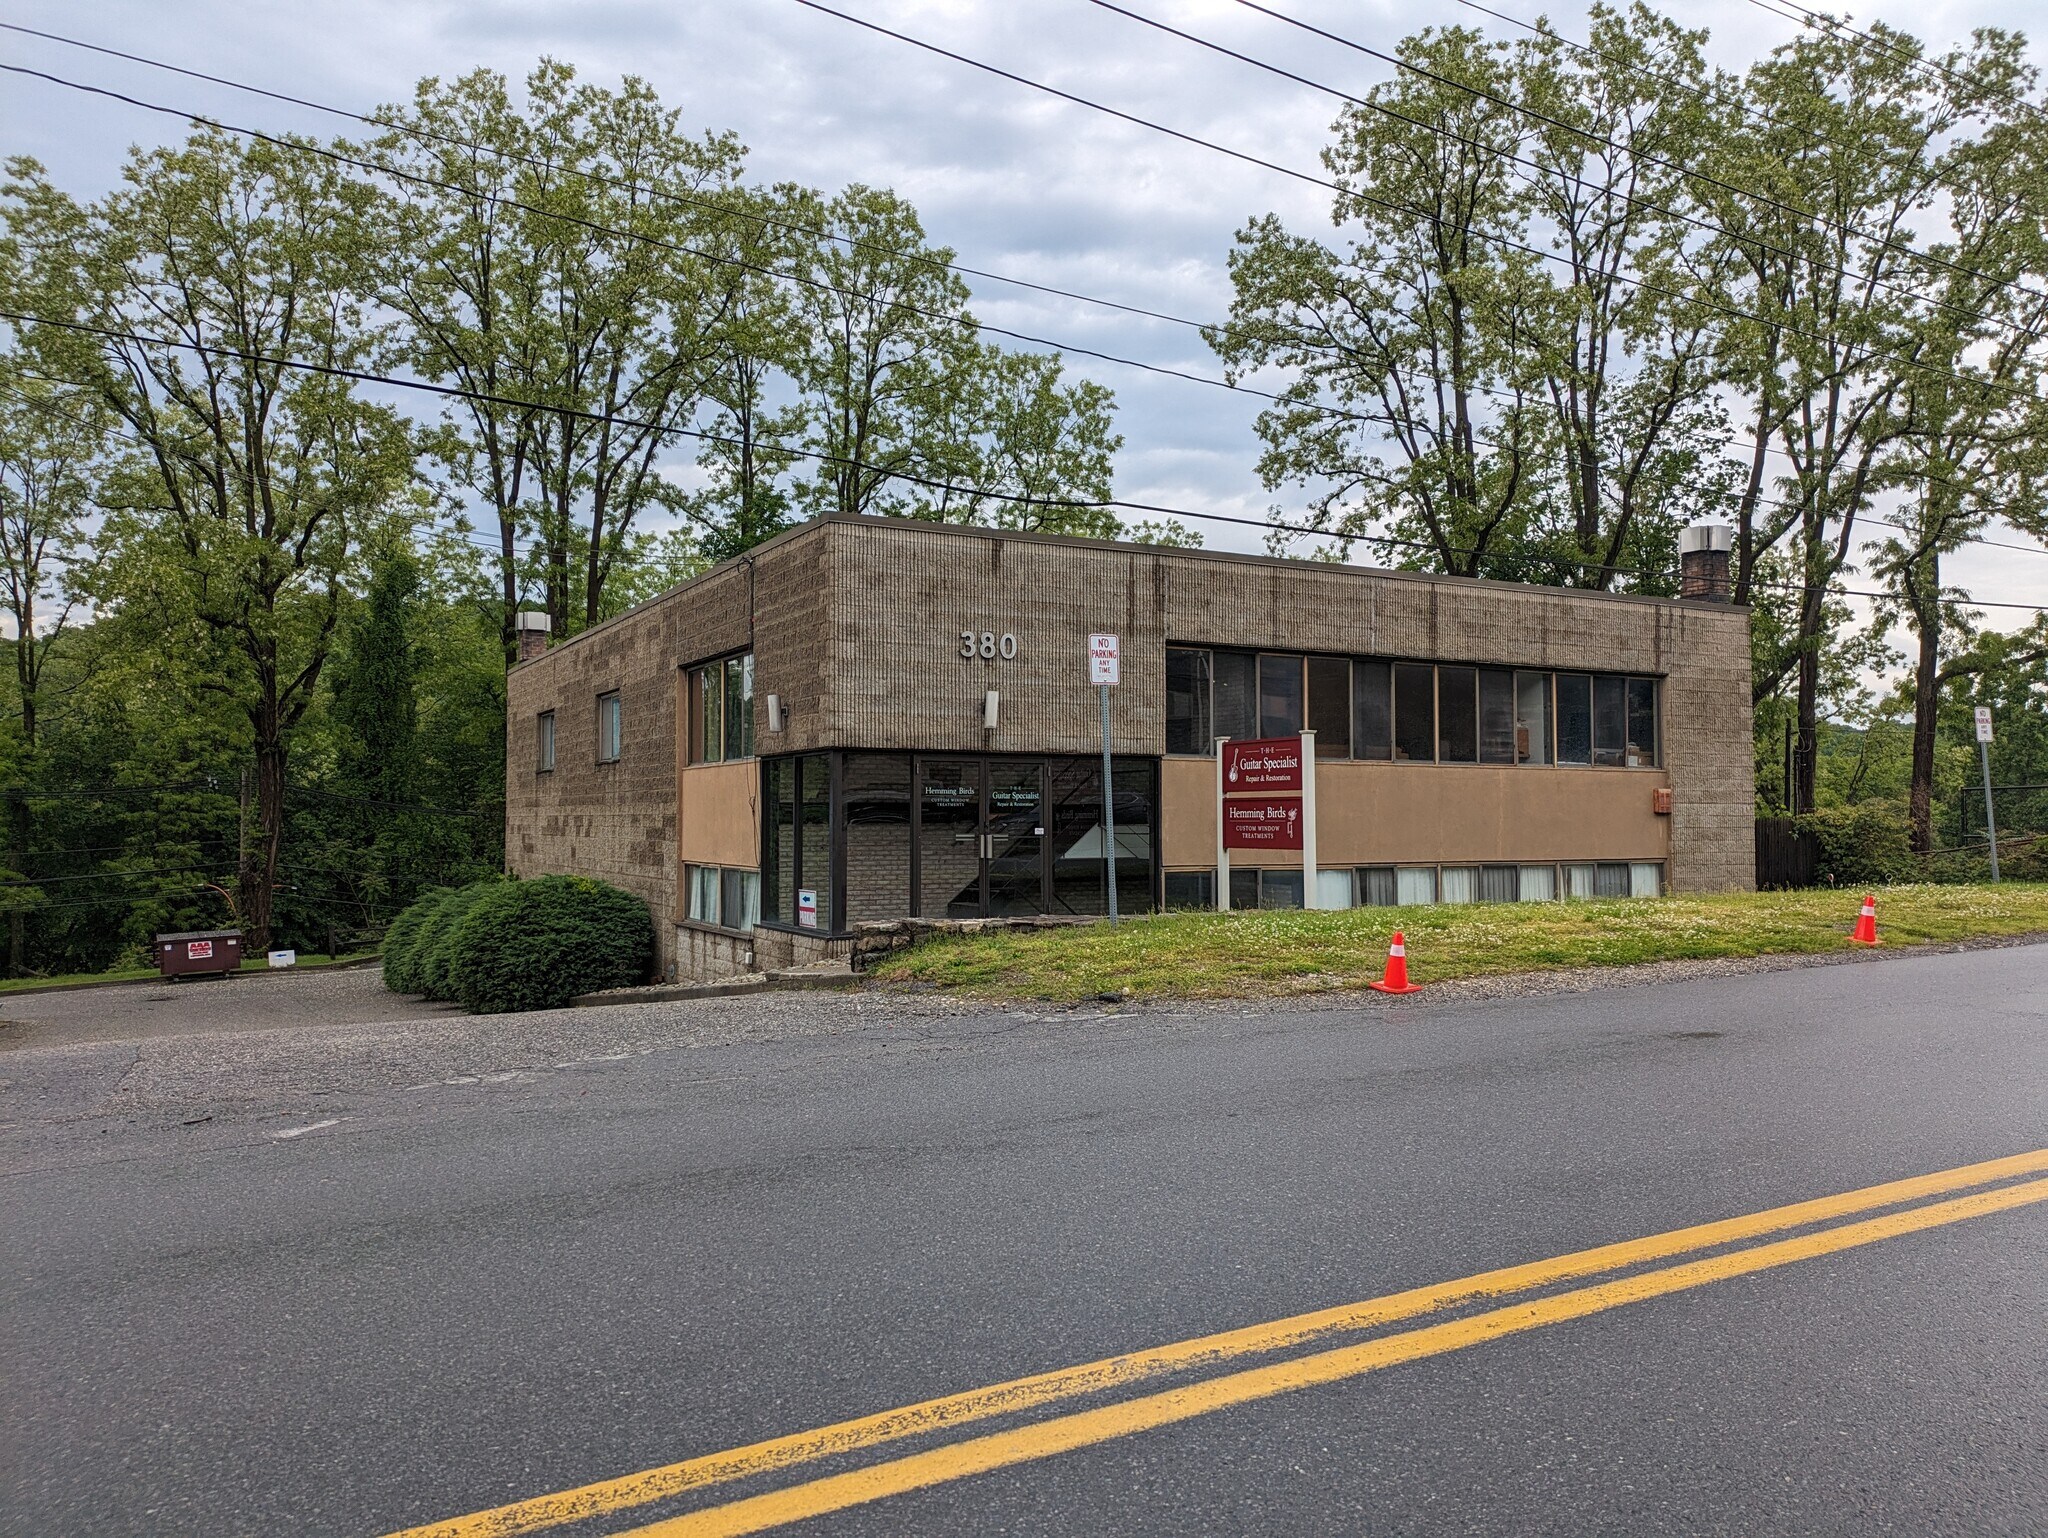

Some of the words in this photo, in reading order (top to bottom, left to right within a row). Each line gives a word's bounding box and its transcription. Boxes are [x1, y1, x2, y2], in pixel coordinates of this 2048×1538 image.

[960, 631, 1017, 659] 380
[1098, 638, 1109, 648] NO
[1091, 650, 1117, 659] PARKING
[1240, 758, 1262, 770] Guitar
[1263, 756, 1298, 772] Specialist
[1245, 775, 1260, 783] Repair
[925, 787, 957, 795] Hemming
[992, 791, 1011, 799] Guitar
[1012, 791, 1040, 801] Specialist
[1229, 807, 1265, 821] Hemming
[1267, 806, 1287, 818] Birds
